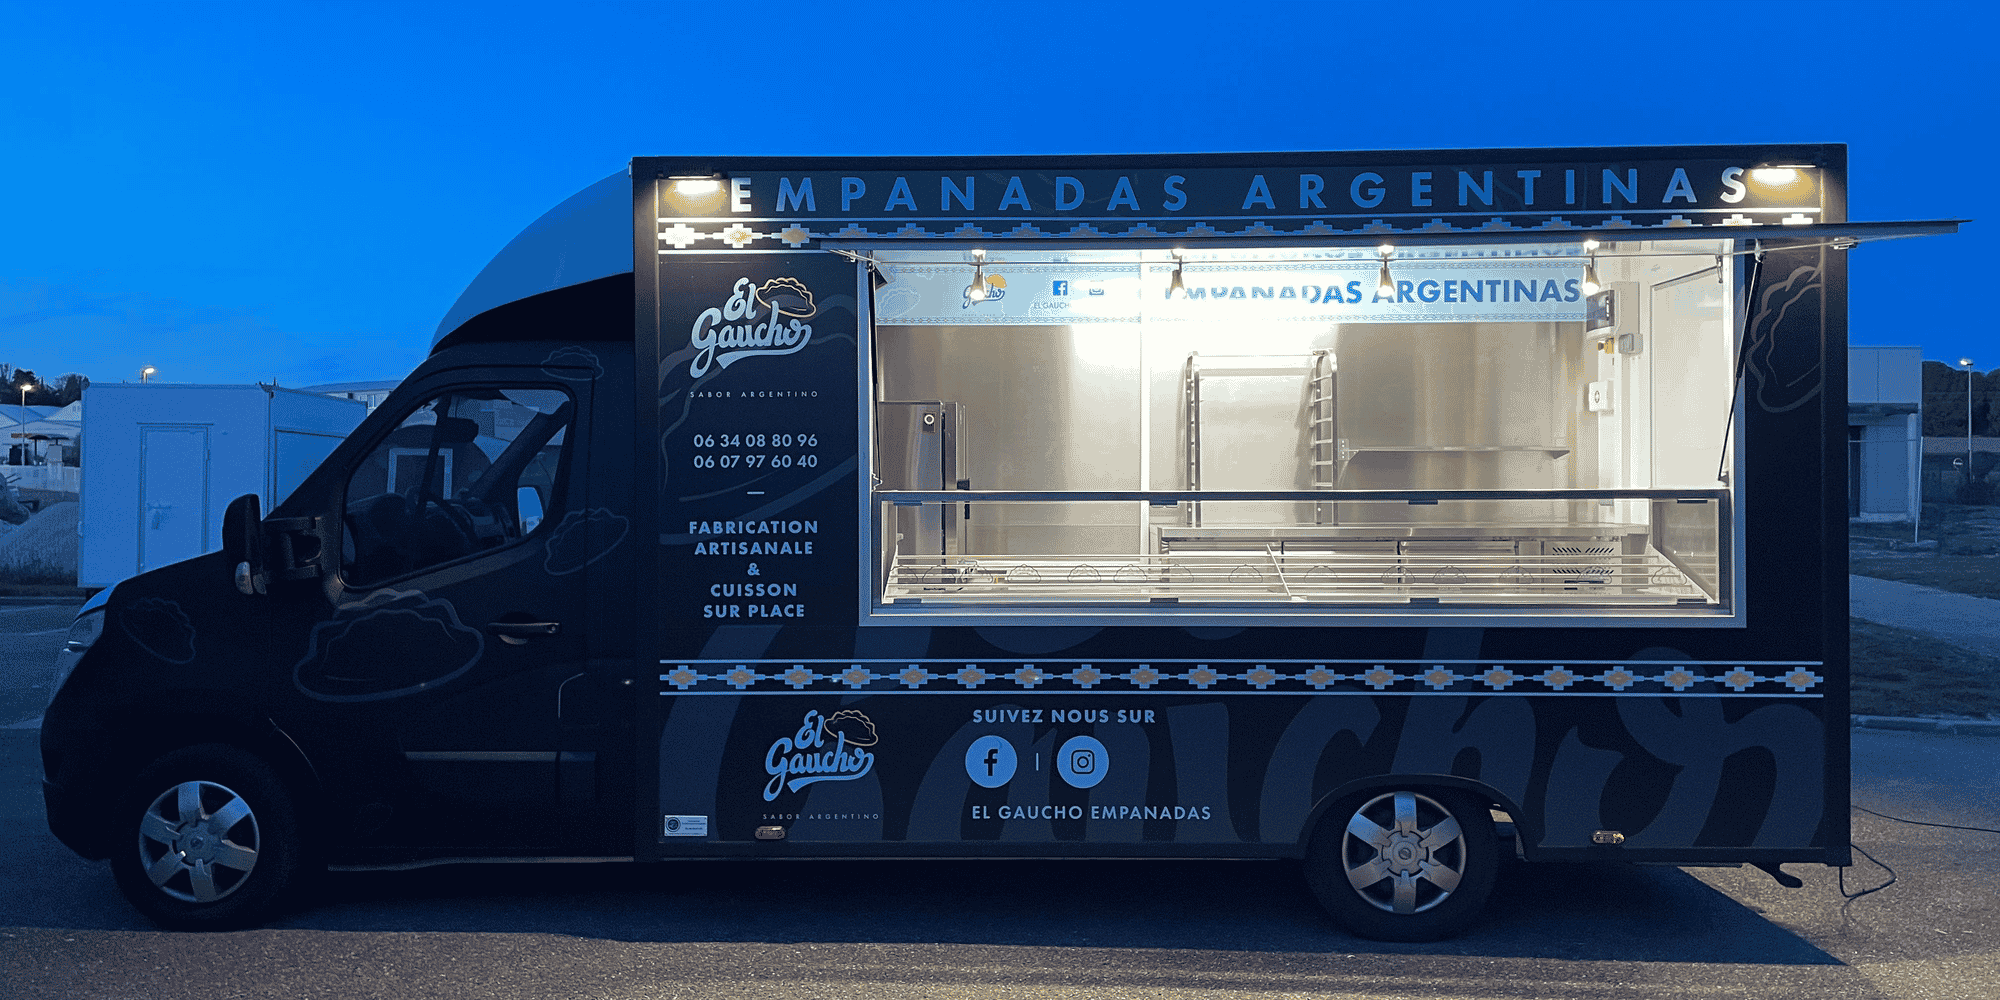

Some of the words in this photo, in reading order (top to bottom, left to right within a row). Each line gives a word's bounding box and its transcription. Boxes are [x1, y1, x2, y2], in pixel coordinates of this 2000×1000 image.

[730, 175, 1189, 213] EMPANADAS
[1241, 166, 1749, 210] ARGENTINAS
[723, 276, 758, 323] El
[689, 300, 813, 380] Gaucho
[689, 390, 732, 399] SABOR
[740, 390, 819, 399] ARGENTINO
[693, 433, 715, 448] 06
[719, 433, 741, 448] 34
[745, 433, 766, 448] 08
[771, 433, 792, 448] 80
[797, 433, 818, 448] 96
[693, 454, 715, 469] 06
[719, 454, 741, 469] 07
[745, 454, 766, 469] 97
[771, 454, 792, 469] 60
[797, 454, 818, 469] 40
[689, 520, 819, 535] FABRICATION
[694, 541, 813, 556] ARTISANALE
[747, 562, 761, 577] &
[710, 583, 797, 598] CUISSON
[703, 604, 741, 619] SUR
[748, 604, 805, 619] PLACE
[972, 709, 1044, 724] SUIVEZ
[1051, 709, 1109, 724] NOUS
[1117, 709, 1156, 724] SUR
[793, 709, 825, 750] El
[762, 730, 875, 803] Gaucho
[762, 812, 801, 821] SABOR
[808, 812, 881, 821] ARGENTINO
[972, 805, 992, 820] EL
[998, 805, 1084, 820] GAUCHO
[1090, 805, 1212, 820] EMPANADAS
